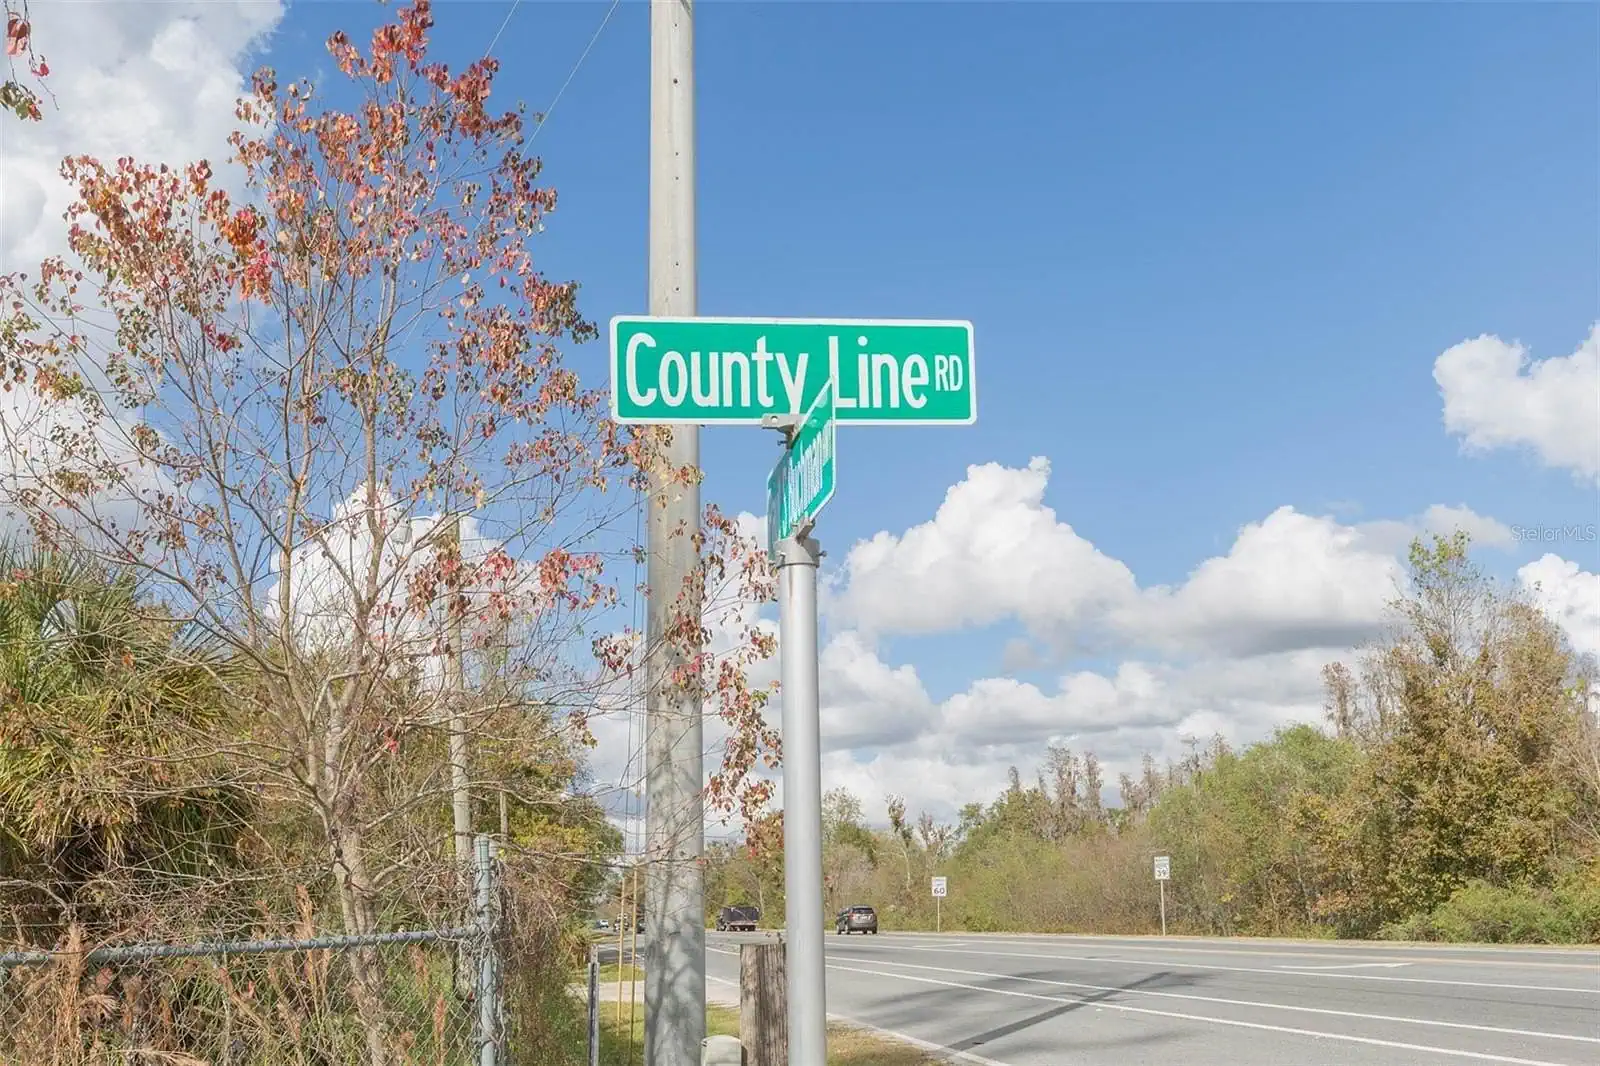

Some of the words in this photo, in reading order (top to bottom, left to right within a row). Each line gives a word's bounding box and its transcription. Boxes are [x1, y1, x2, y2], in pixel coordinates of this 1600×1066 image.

[625, 332, 808, 414] County
[828, 335, 929, 409] Line
[935, 355, 963, 392] RD
